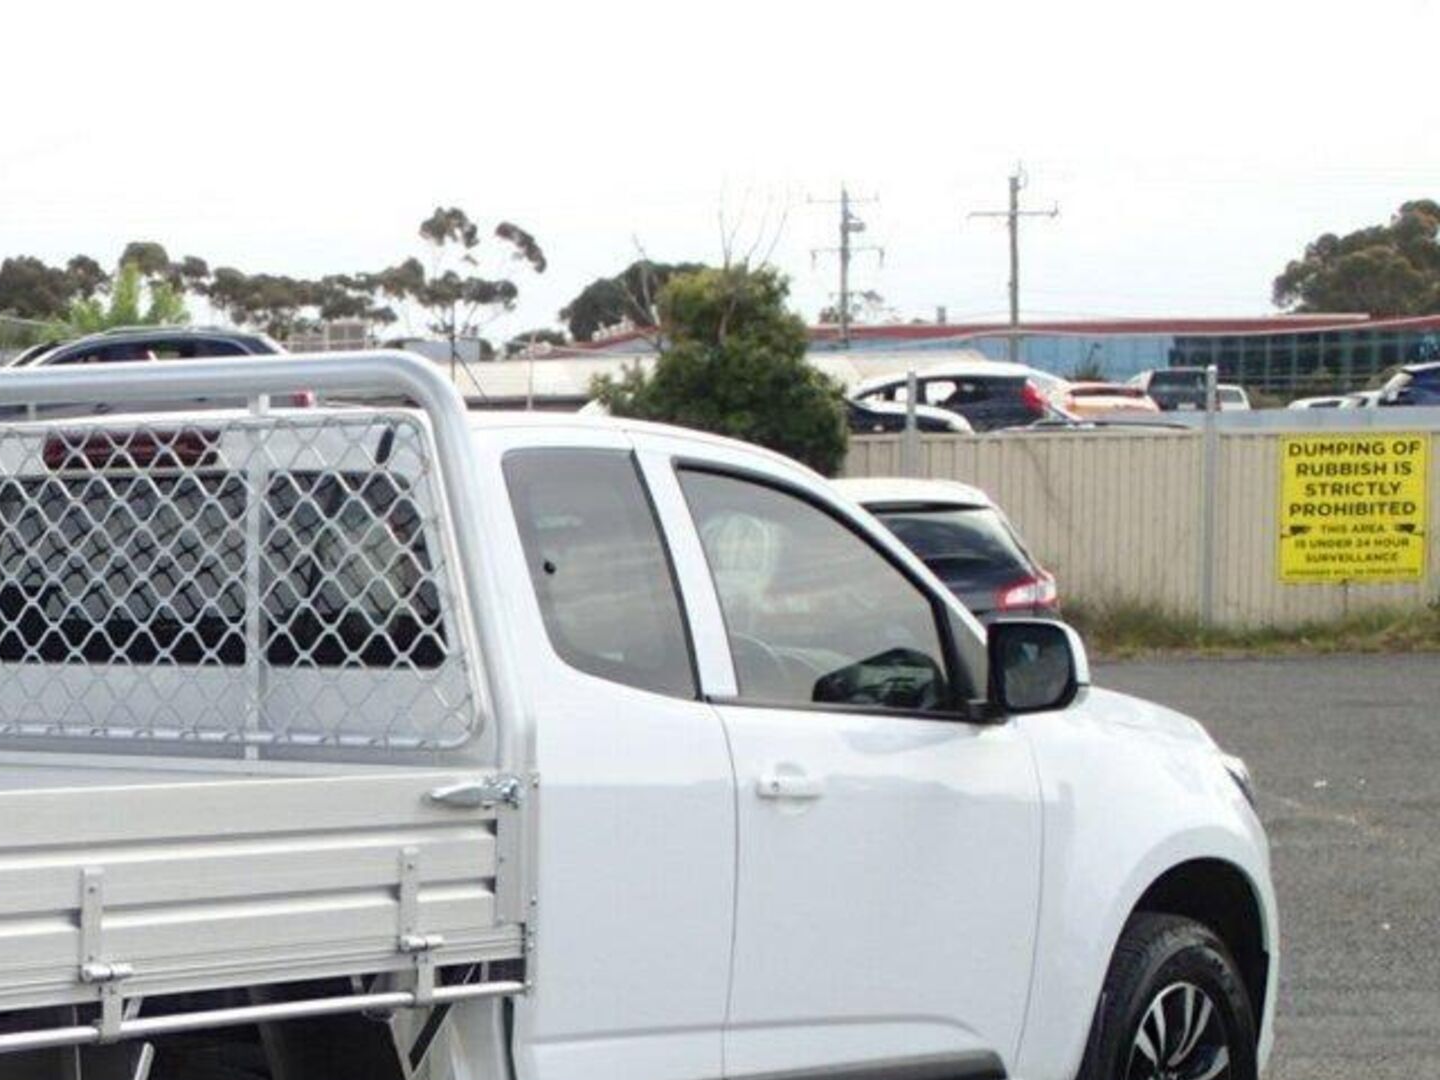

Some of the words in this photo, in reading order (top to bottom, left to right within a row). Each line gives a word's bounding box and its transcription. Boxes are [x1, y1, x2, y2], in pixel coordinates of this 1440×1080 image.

[1289, 442, 1385, 457] DUMPING
[1392, 440, 1421, 455] OF
[1296, 462, 1387, 477] RUBBISH
[1394, 461, 1412, 475] IS
[1305, 481, 1401, 496] STRICTLY
[1289, 501, 1416, 517] PROHIBITED
[1321, 524, 1347, 533] THIS
[1351, 524, 1385, 533] AREA
[1309, 539, 1352, 549] UNDER
[1305, 552, 1399, 563] SURVEILLANCE
